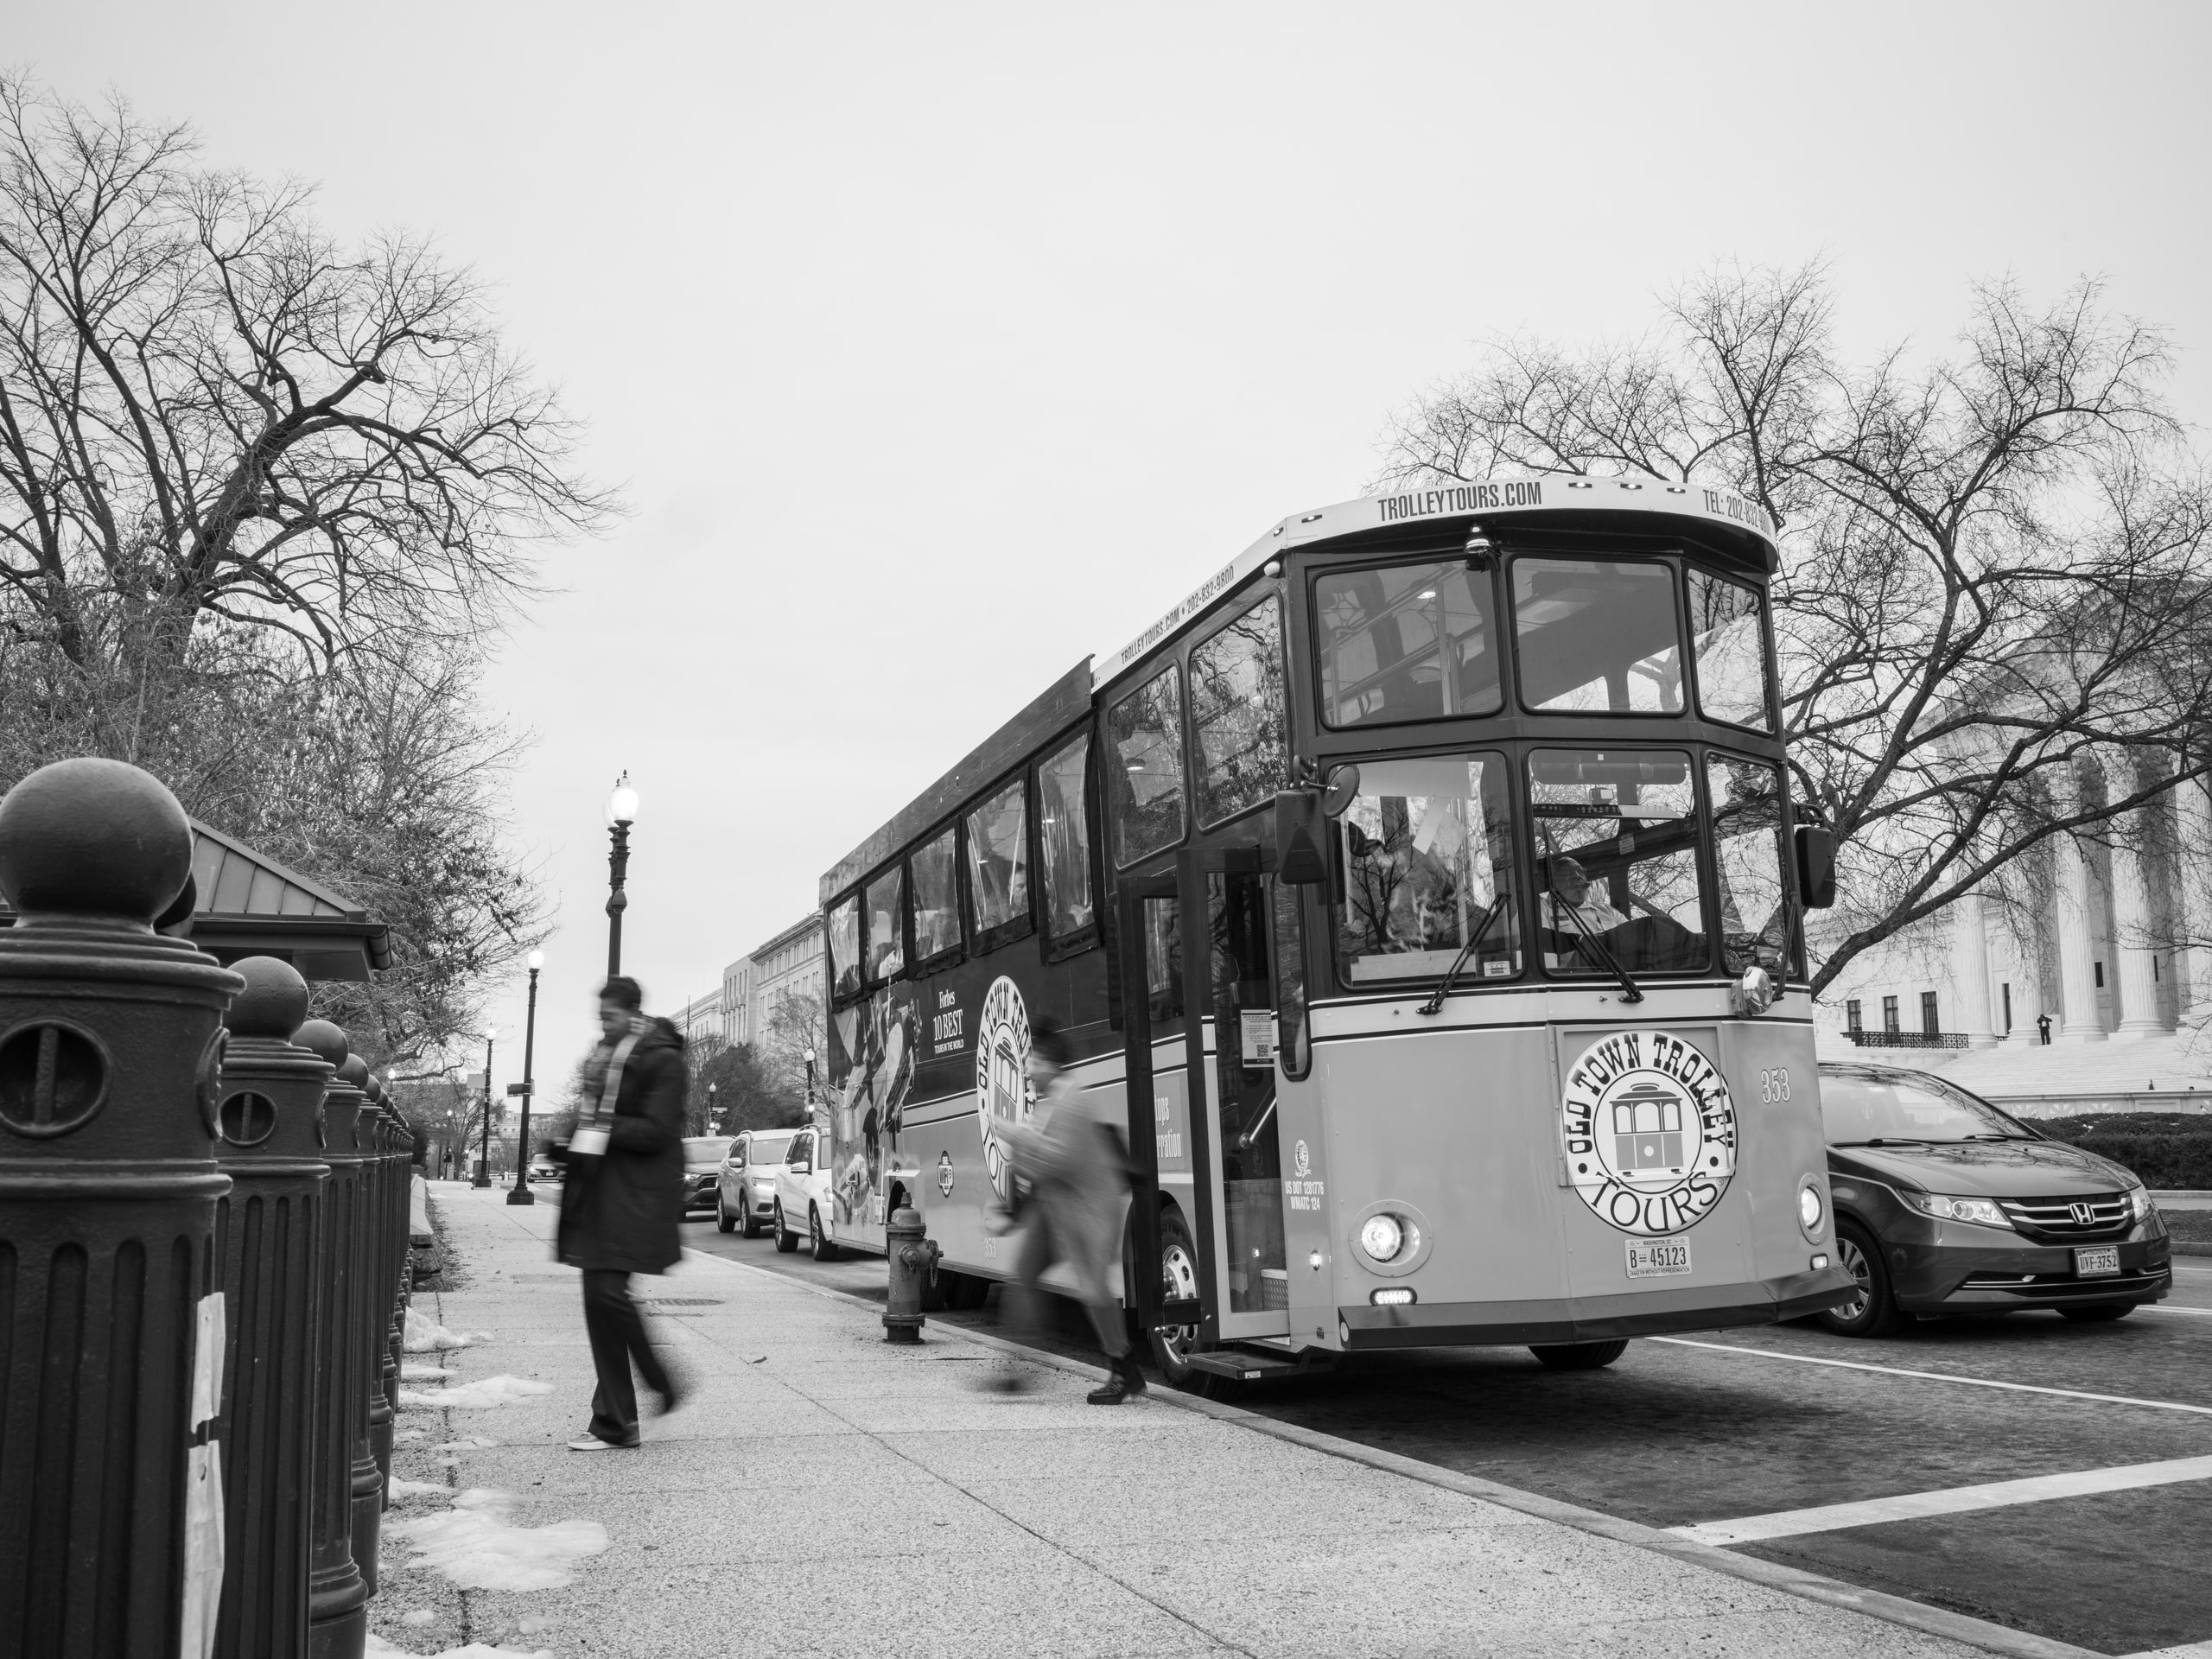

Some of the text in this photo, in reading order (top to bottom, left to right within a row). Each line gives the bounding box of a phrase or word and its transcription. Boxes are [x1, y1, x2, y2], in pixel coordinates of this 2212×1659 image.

[1378, 481, 1542, 522] TROLLEYTOURS.COM
[1702, 489, 1725, 516] TEL:
[1122, 565, 1235, 664] TROLLEYTOURS.COM 202-832-9800
[938, 988, 956, 1009] Forbes
[933, 1008, 963, 1041] 10 BEST
[979, 1029, 989, 1091] OLD
[985, 981, 1009, 1036] TOWN
[1567, 1033, 1734, 1154] OLD TOWN TROLLEY
[1761, 1066, 1791, 1105] 353
[1285, 1180, 1325, 1196] US DOT 1281776
[1290, 1196, 1310, 1211] WMATC
[1311, 1197, 1320, 1211] 124
[1591, 1171, 1719, 1232] TOURS
[1650, 1246, 1687, 1267] 45123
[2080, 1255, 2117, 1270] UVF-3752
